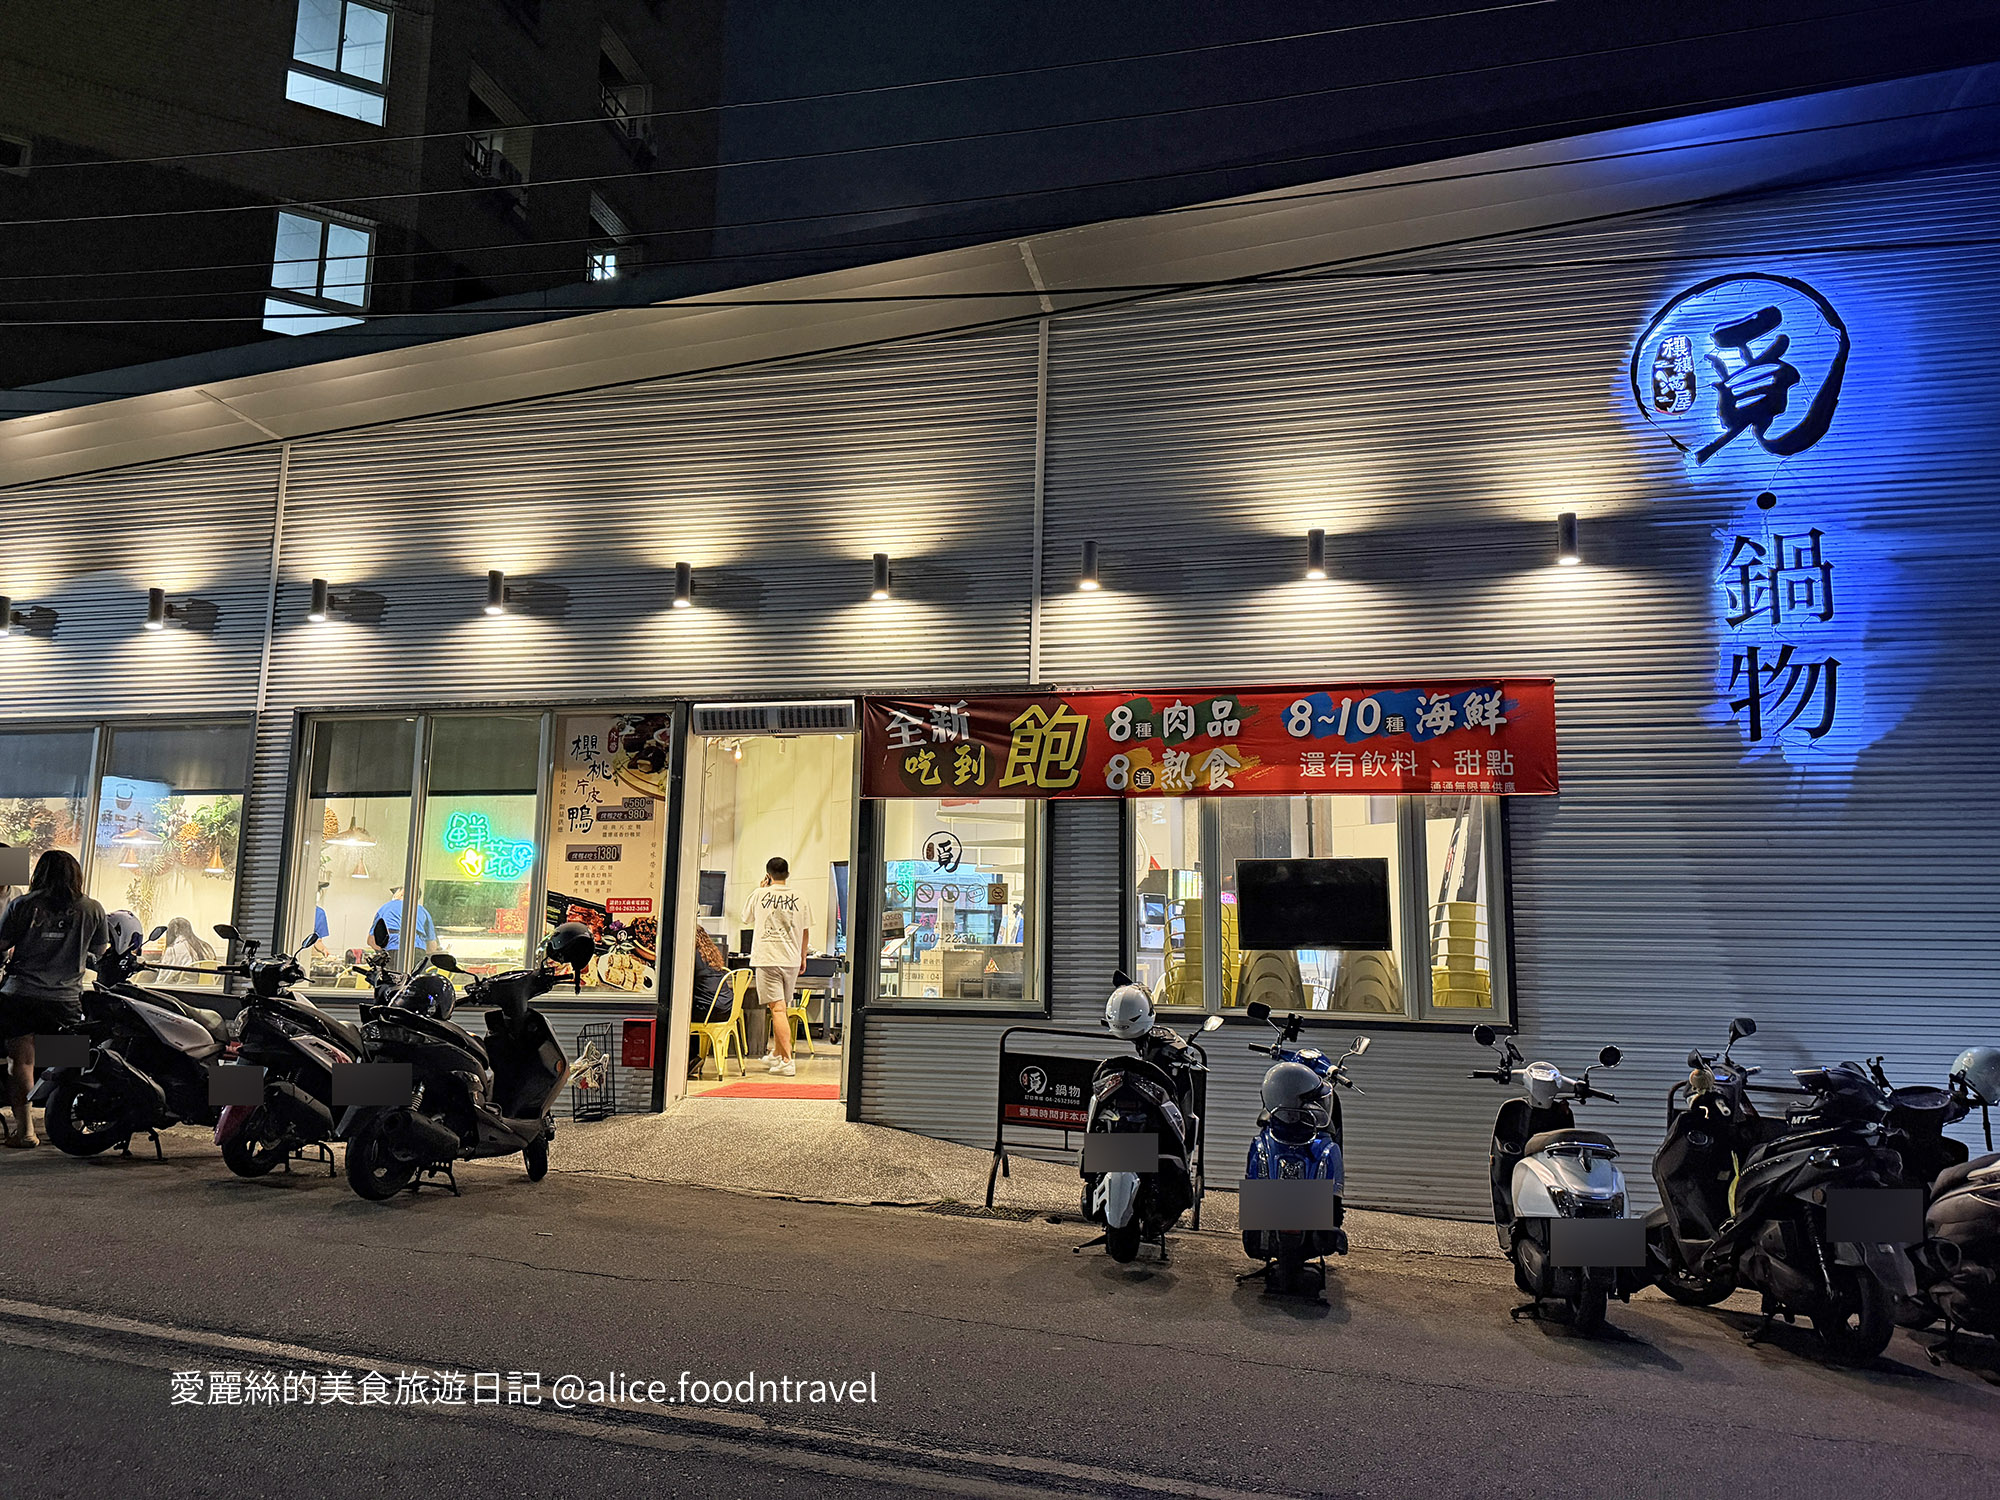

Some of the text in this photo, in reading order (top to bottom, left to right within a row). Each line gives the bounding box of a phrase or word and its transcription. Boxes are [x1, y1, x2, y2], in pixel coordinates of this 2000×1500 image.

[1694, 300, 1848, 466] 覓
[885, 699, 970, 750] 全新
[761, 891, 799, 912] SHARK
